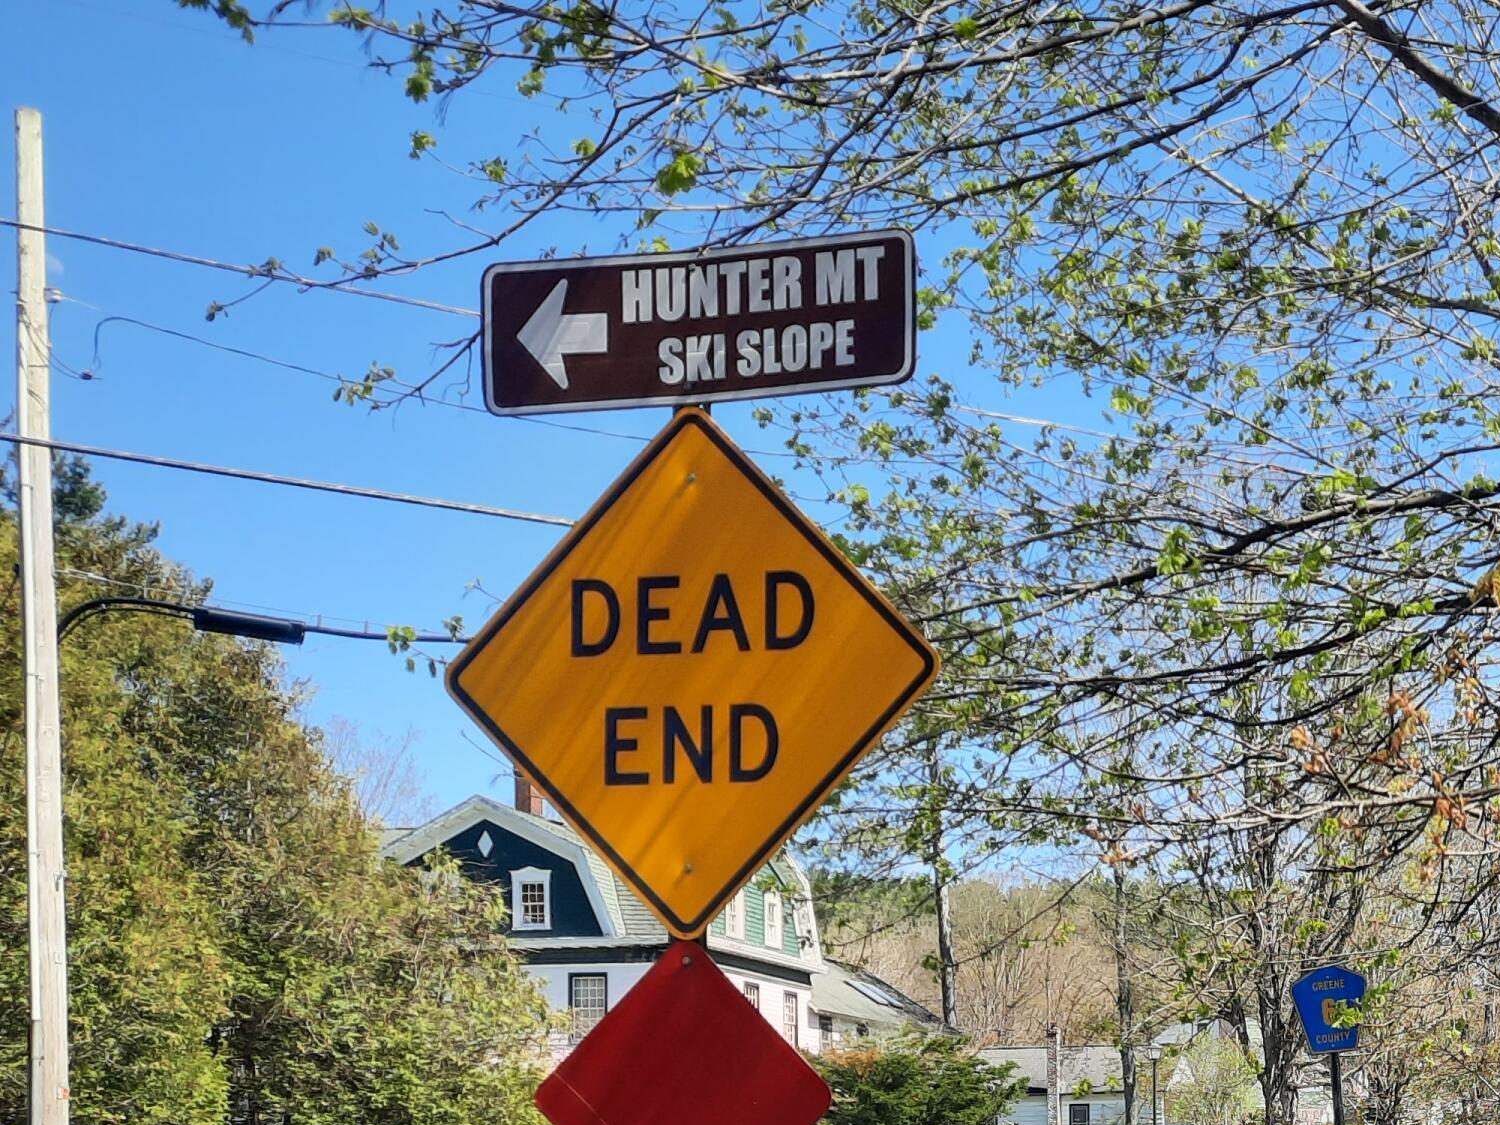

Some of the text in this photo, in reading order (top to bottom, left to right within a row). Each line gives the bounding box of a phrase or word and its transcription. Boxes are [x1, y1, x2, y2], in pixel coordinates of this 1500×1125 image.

[621, 246, 885, 323] HUNTER MT
[658, 319, 855, 386] SKI SLOPE
[571, 571, 815, 657] DEAD
[604, 703, 779, 786] END
[1312, 979, 1345, 992] GREENE
[1315, 1031, 1351, 1044] COUNTY
